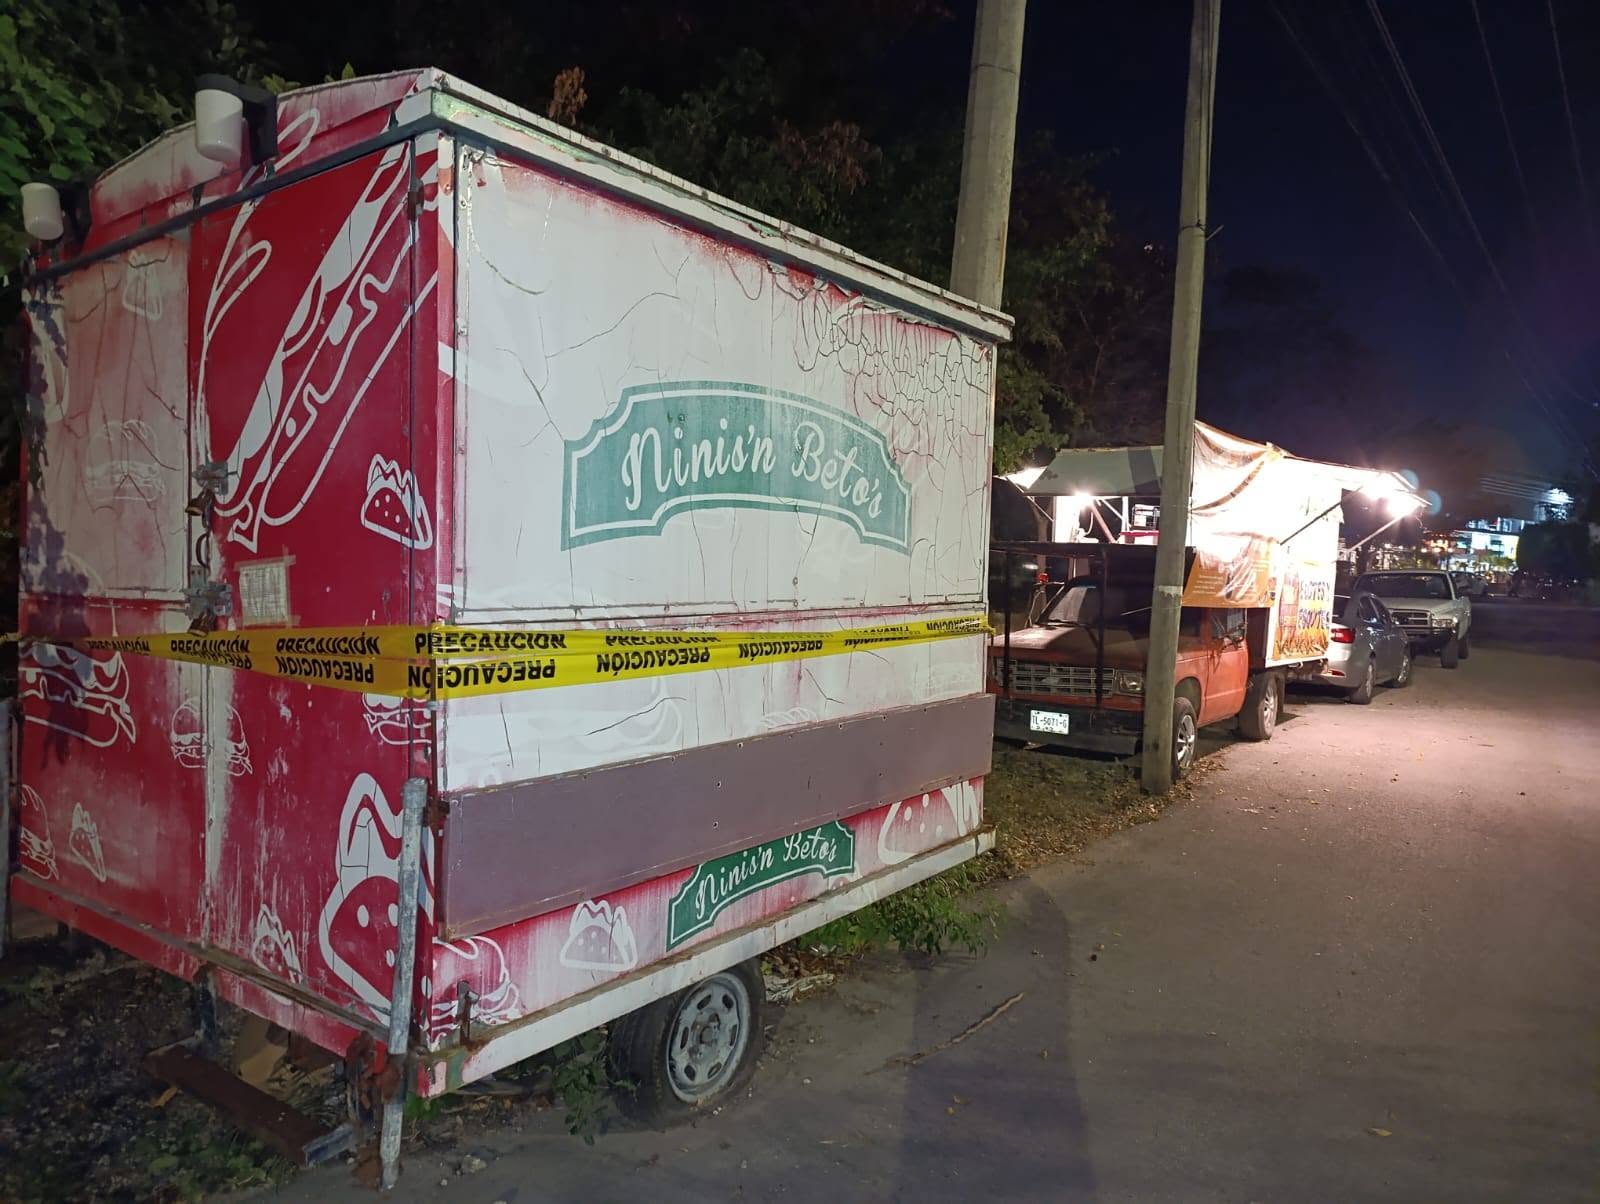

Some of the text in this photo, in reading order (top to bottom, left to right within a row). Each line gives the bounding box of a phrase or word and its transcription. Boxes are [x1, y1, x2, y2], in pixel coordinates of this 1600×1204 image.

[622, 418, 881, 518] Ninis'n Beto's
[276, 632, 380, 655] PRECAUCIÓN
[408, 659, 556, 694] PRECAUCIÓN
[596, 647, 711, 676] PRECAUCIÓN
[695, 827, 837, 920] Ninis'n Beto's
